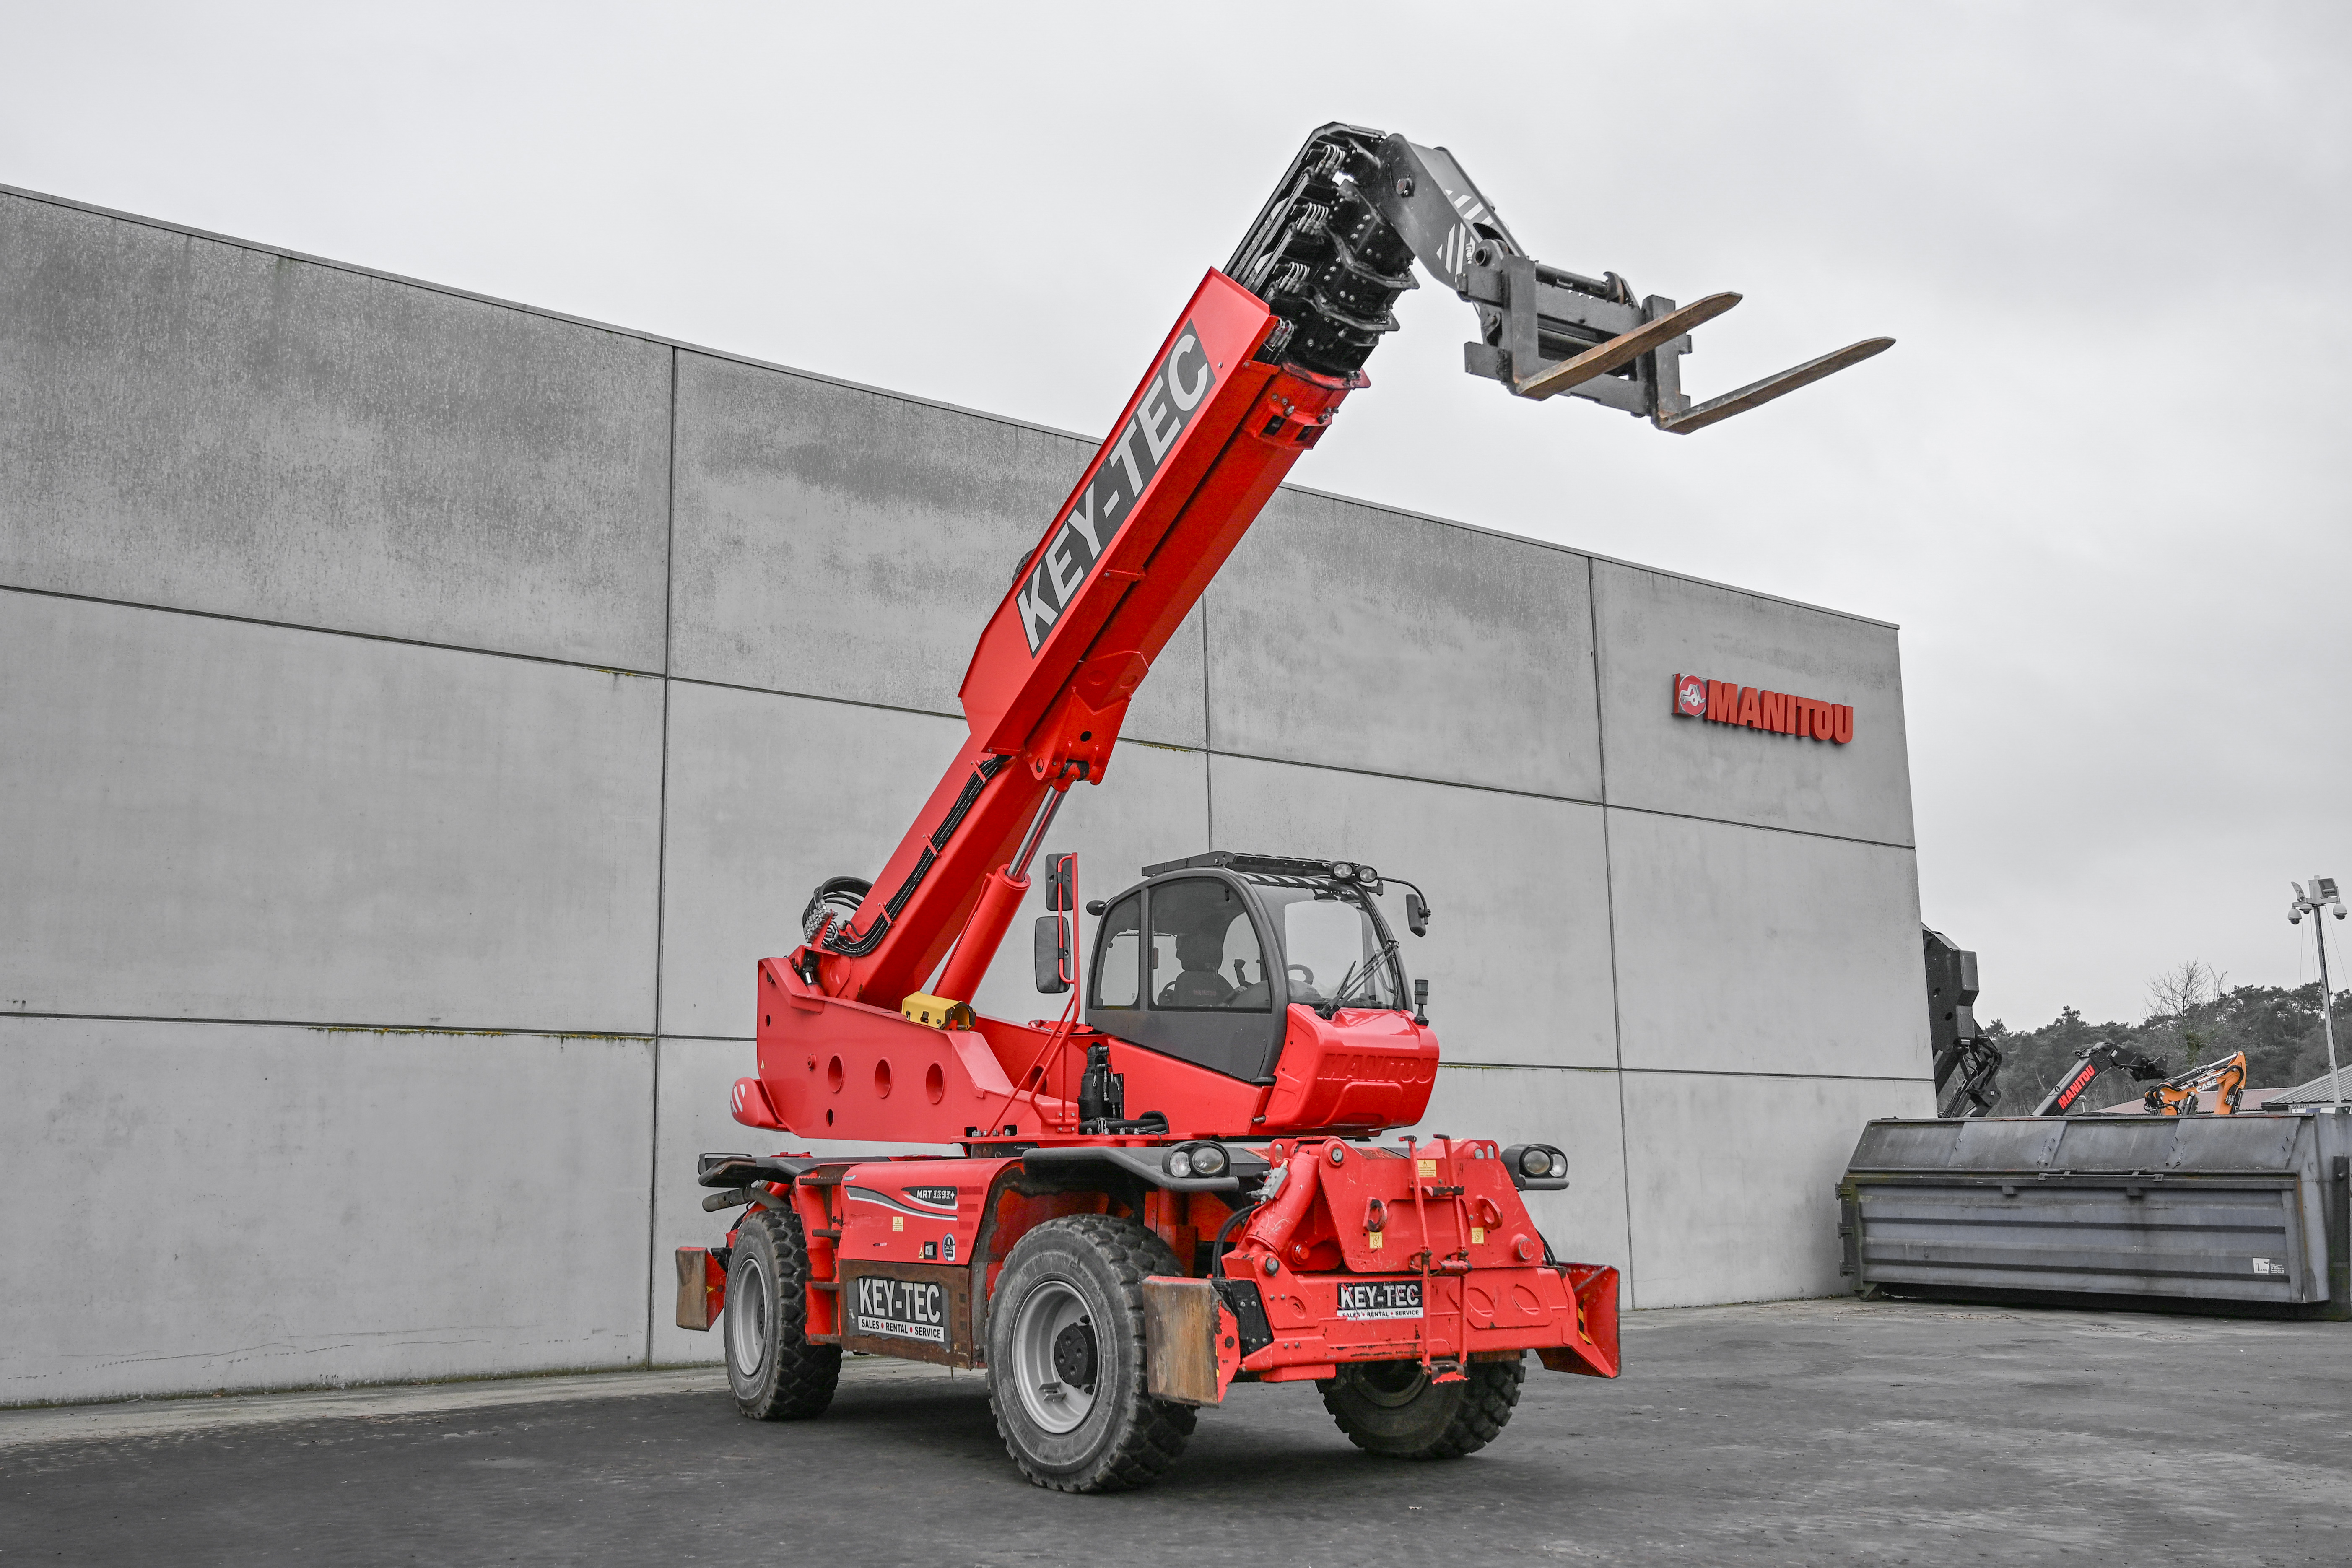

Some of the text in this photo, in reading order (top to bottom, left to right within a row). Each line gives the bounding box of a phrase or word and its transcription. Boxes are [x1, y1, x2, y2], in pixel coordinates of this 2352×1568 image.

[1017, 334, 1207, 653] KEY-TEC
[1704, 679, 1854, 744] MANITOU
[1317, 1053, 1438, 1083] MANITOU
[2057, 1064, 2095, 1109] MANITOU
[2196, 1078, 2217, 1092] CASE
[916, 1189, 932, 1199] MRT
[859, 1278, 941, 1324] KEY-TEC
[1341, 1284, 1419, 1308] KEY-TEC
[862, 1319, 941, 1338] SALES RENTAL SERVICE
